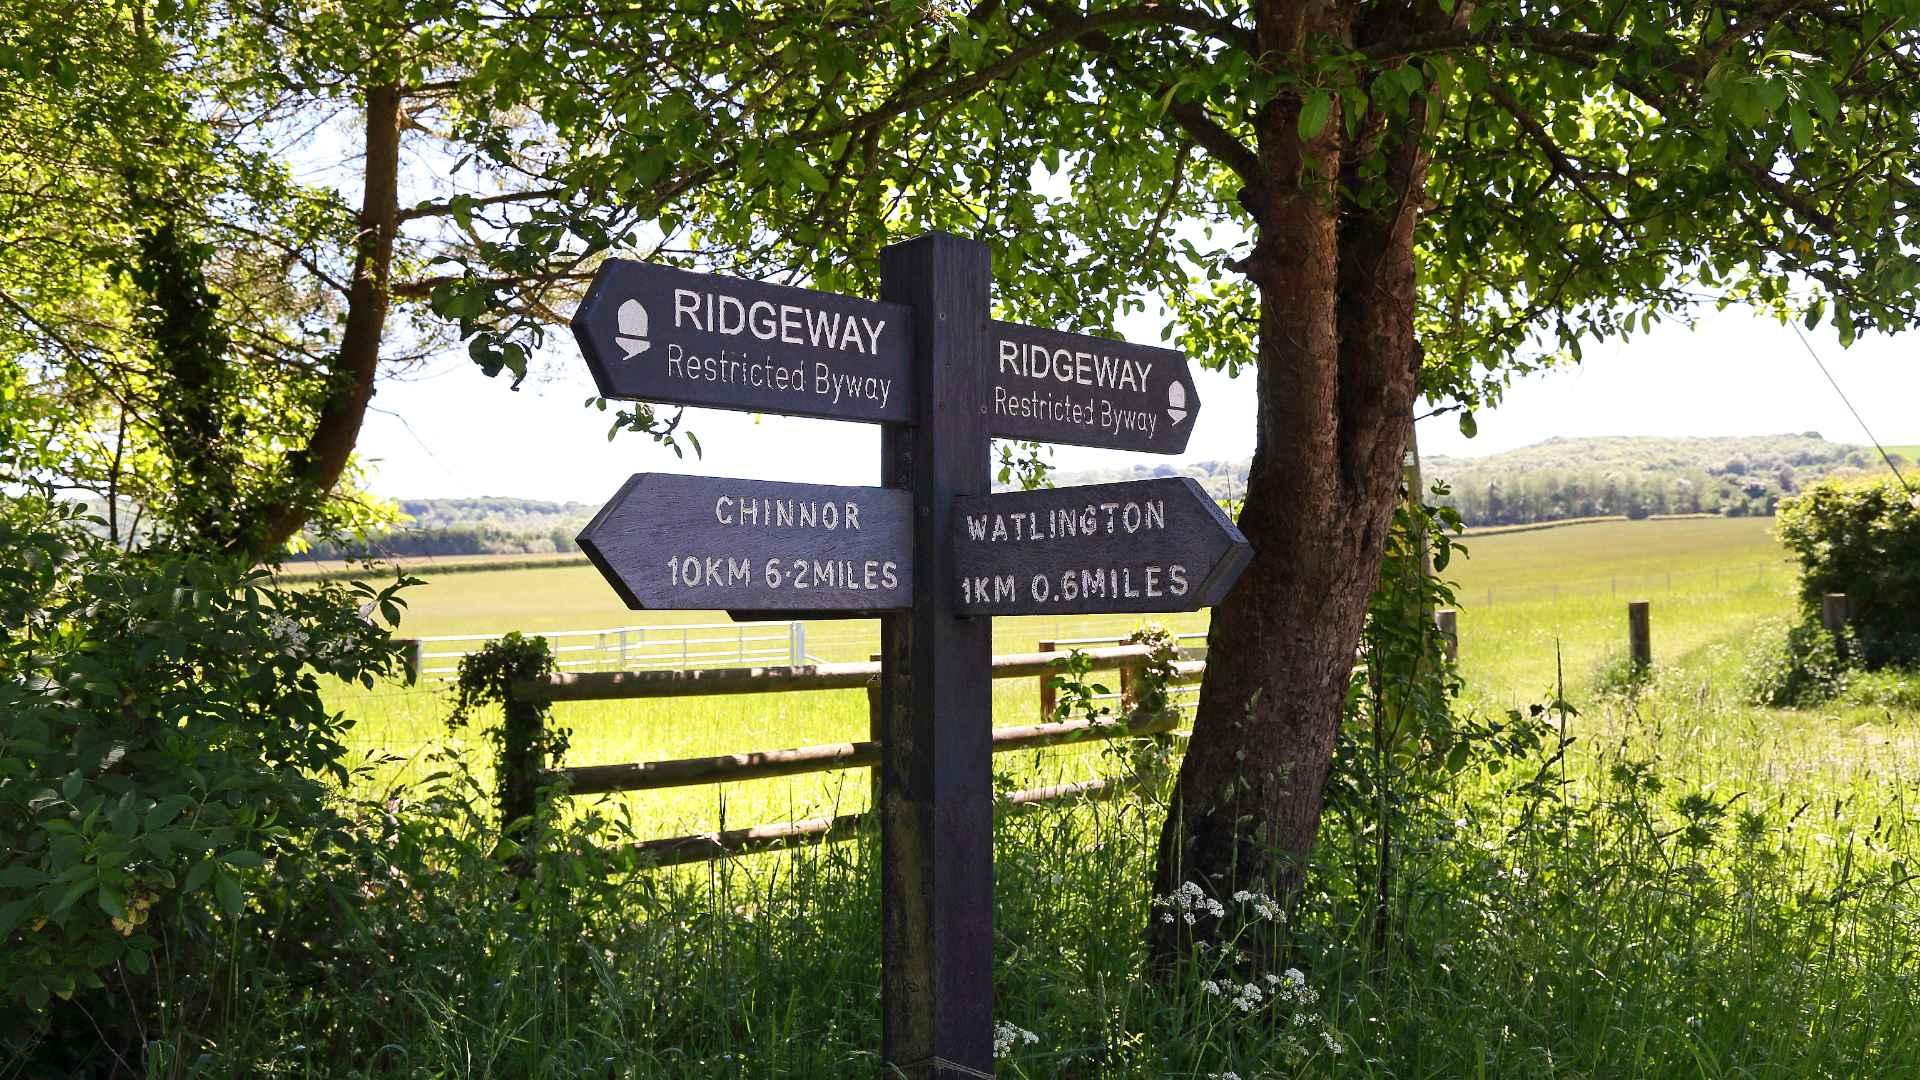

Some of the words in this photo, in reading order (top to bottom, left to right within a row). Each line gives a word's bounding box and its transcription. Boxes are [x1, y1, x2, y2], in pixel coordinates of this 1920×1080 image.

[674, 288, 885, 355] RIDGEWAY
[667, 343, 805, 392] Restricted
[814, 362, 891, 409] Byway
[999, 340, 1152, 393] RIDGEWAY
[994, 385, 1094, 426] Restricted
[1101, 400, 1157, 439] Byway
[715, 495, 861, 530] CHINNOR
[966, 500, 1166, 542] WATLINGTON
[668, 555, 751, 587] 10KM
[961, 575, 1016, 604] 1KM
